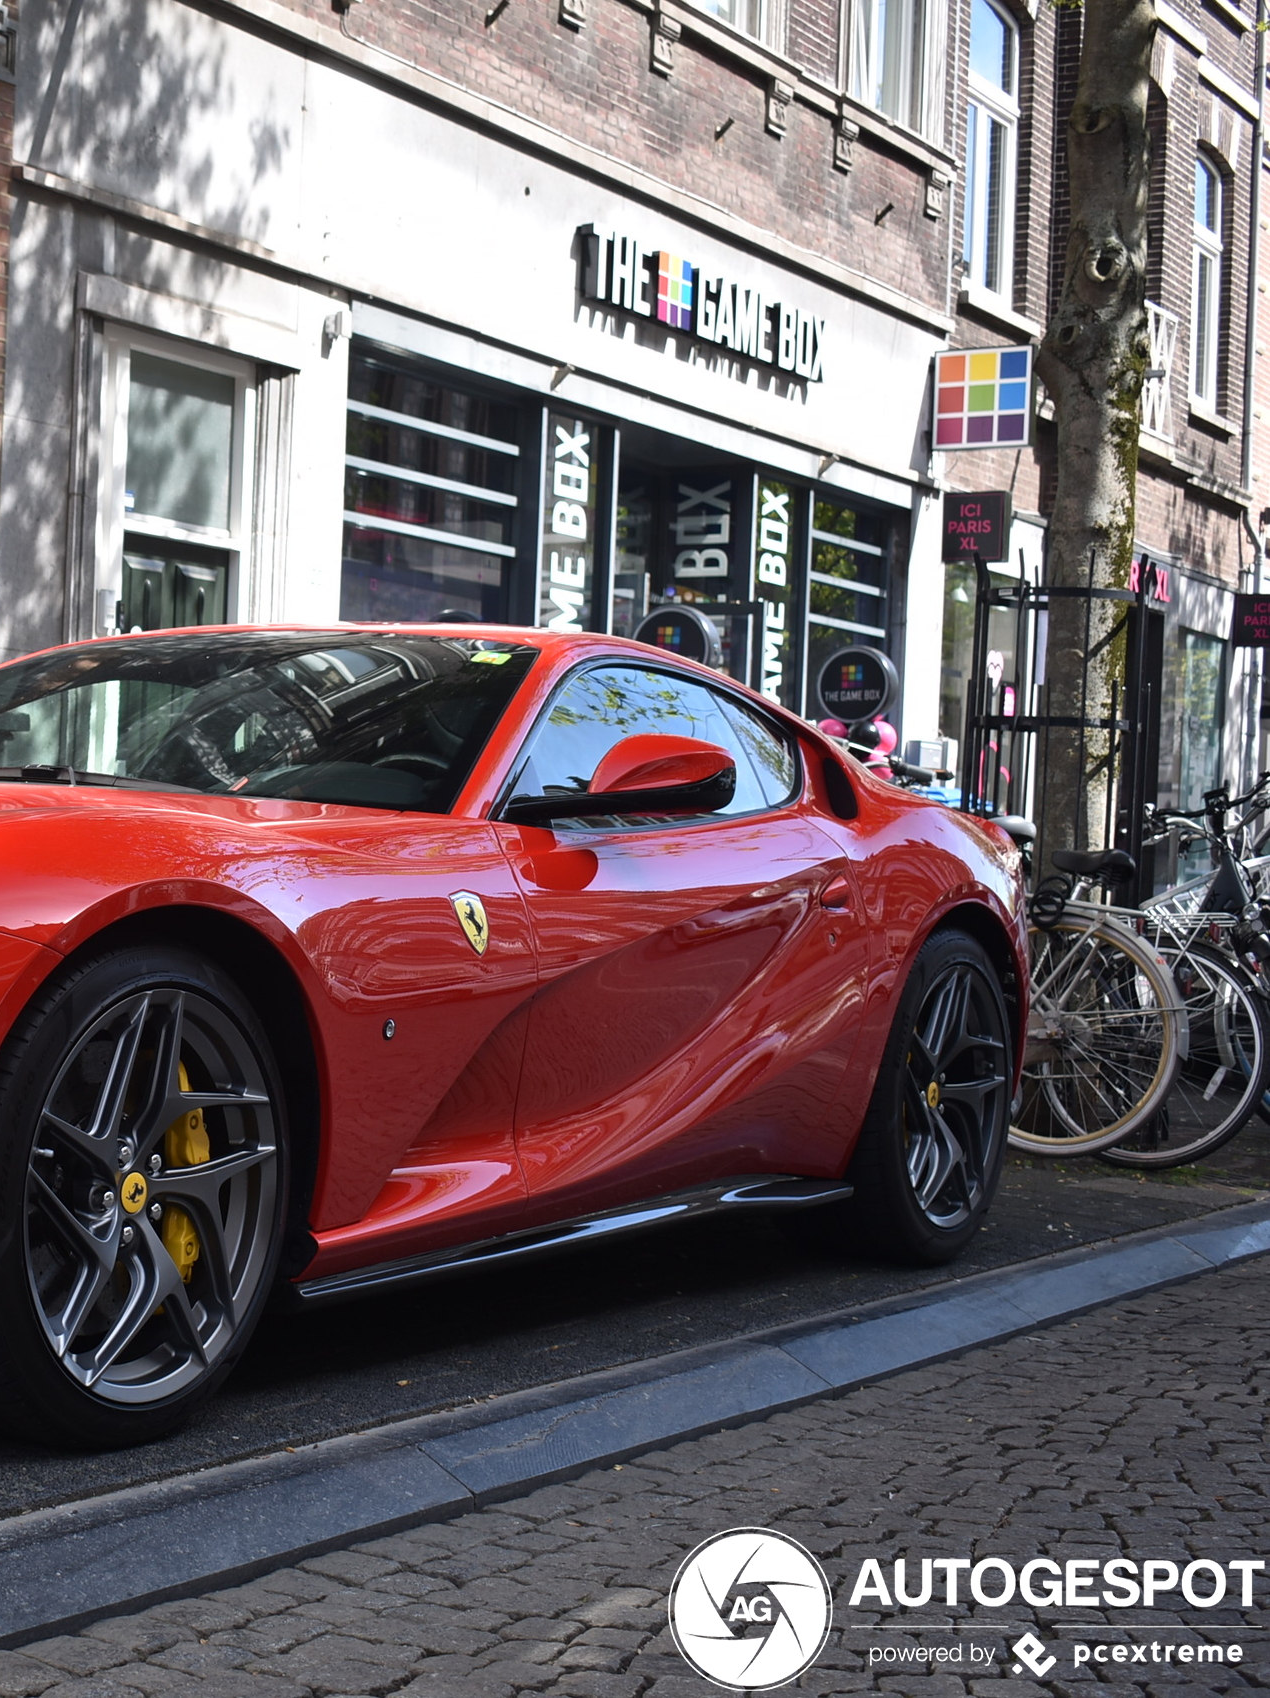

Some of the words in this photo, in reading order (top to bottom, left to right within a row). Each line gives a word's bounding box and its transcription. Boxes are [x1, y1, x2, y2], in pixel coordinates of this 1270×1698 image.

[593, 222, 652, 317] THE
[695, 268, 774, 364] GAME
[777, 302, 830, 382] BOX
[551, 423, 590, 540] BOX
[960, 503, 981, 518] ICI
[673, 480, 732, 579] BOX
[758, 486, 790, 587] BOX
[947, 519, 992, 534] PARIS
[959, 536, 979, 551] XL
[1154, 568, 1171, 603] XL
[1253, 628, 1269, 639] XL
[824, 691, 839, 702] THE
[840, 689, 863, 702] GAME
[864, 688, 881, 701] BOX
